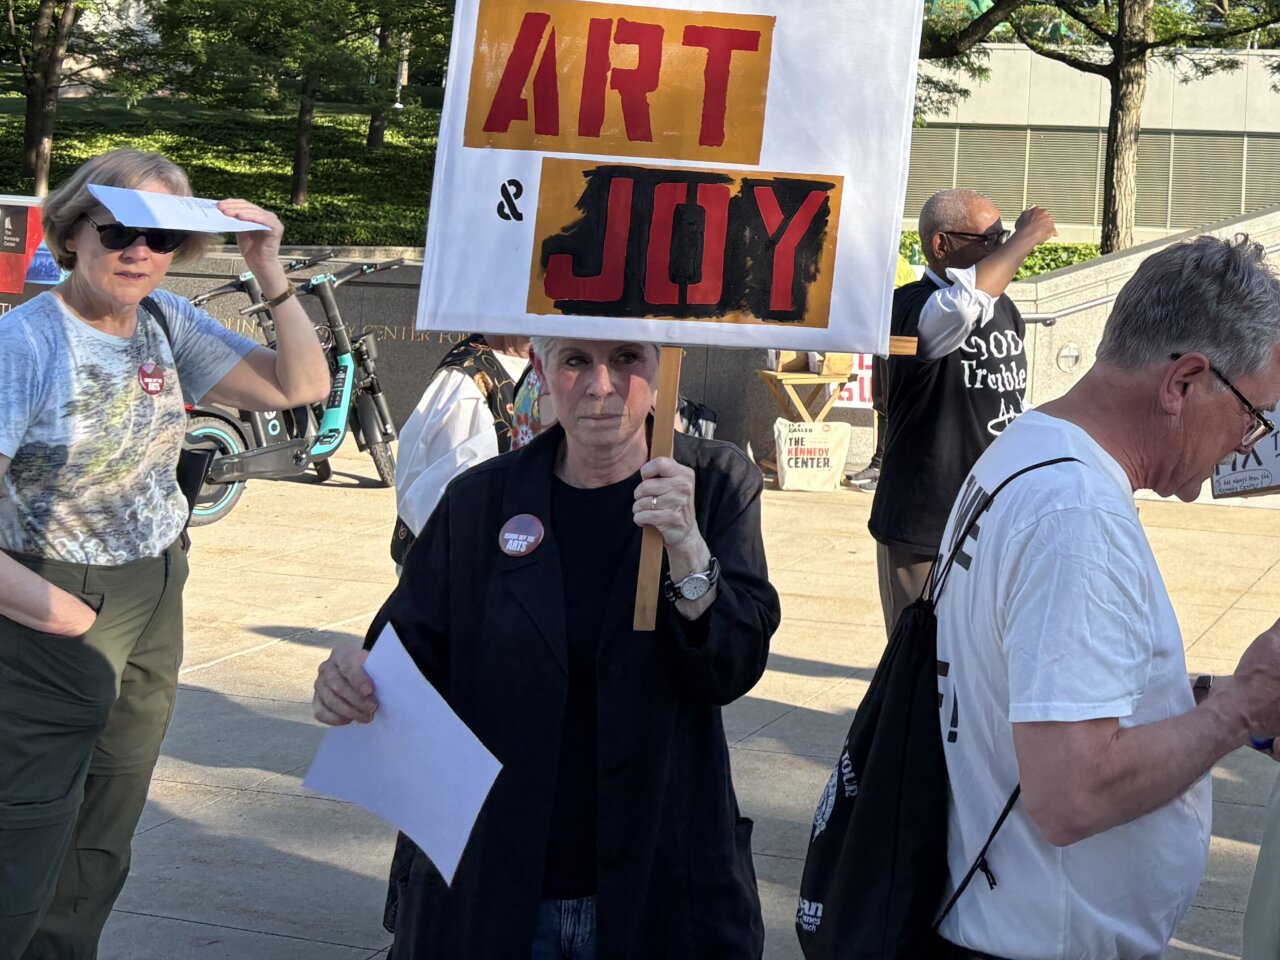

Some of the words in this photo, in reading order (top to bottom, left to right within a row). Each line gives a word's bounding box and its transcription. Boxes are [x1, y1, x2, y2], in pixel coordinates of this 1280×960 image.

[482, 12, 761, 147] ART
[496, 178, 524, 221] &
[544, 177, 824, 310] JOY
[788, 437, 806, 447] THE
[787, 447, 829, 457] KENNEDY
[506, 540, 527, 552] ARTS
